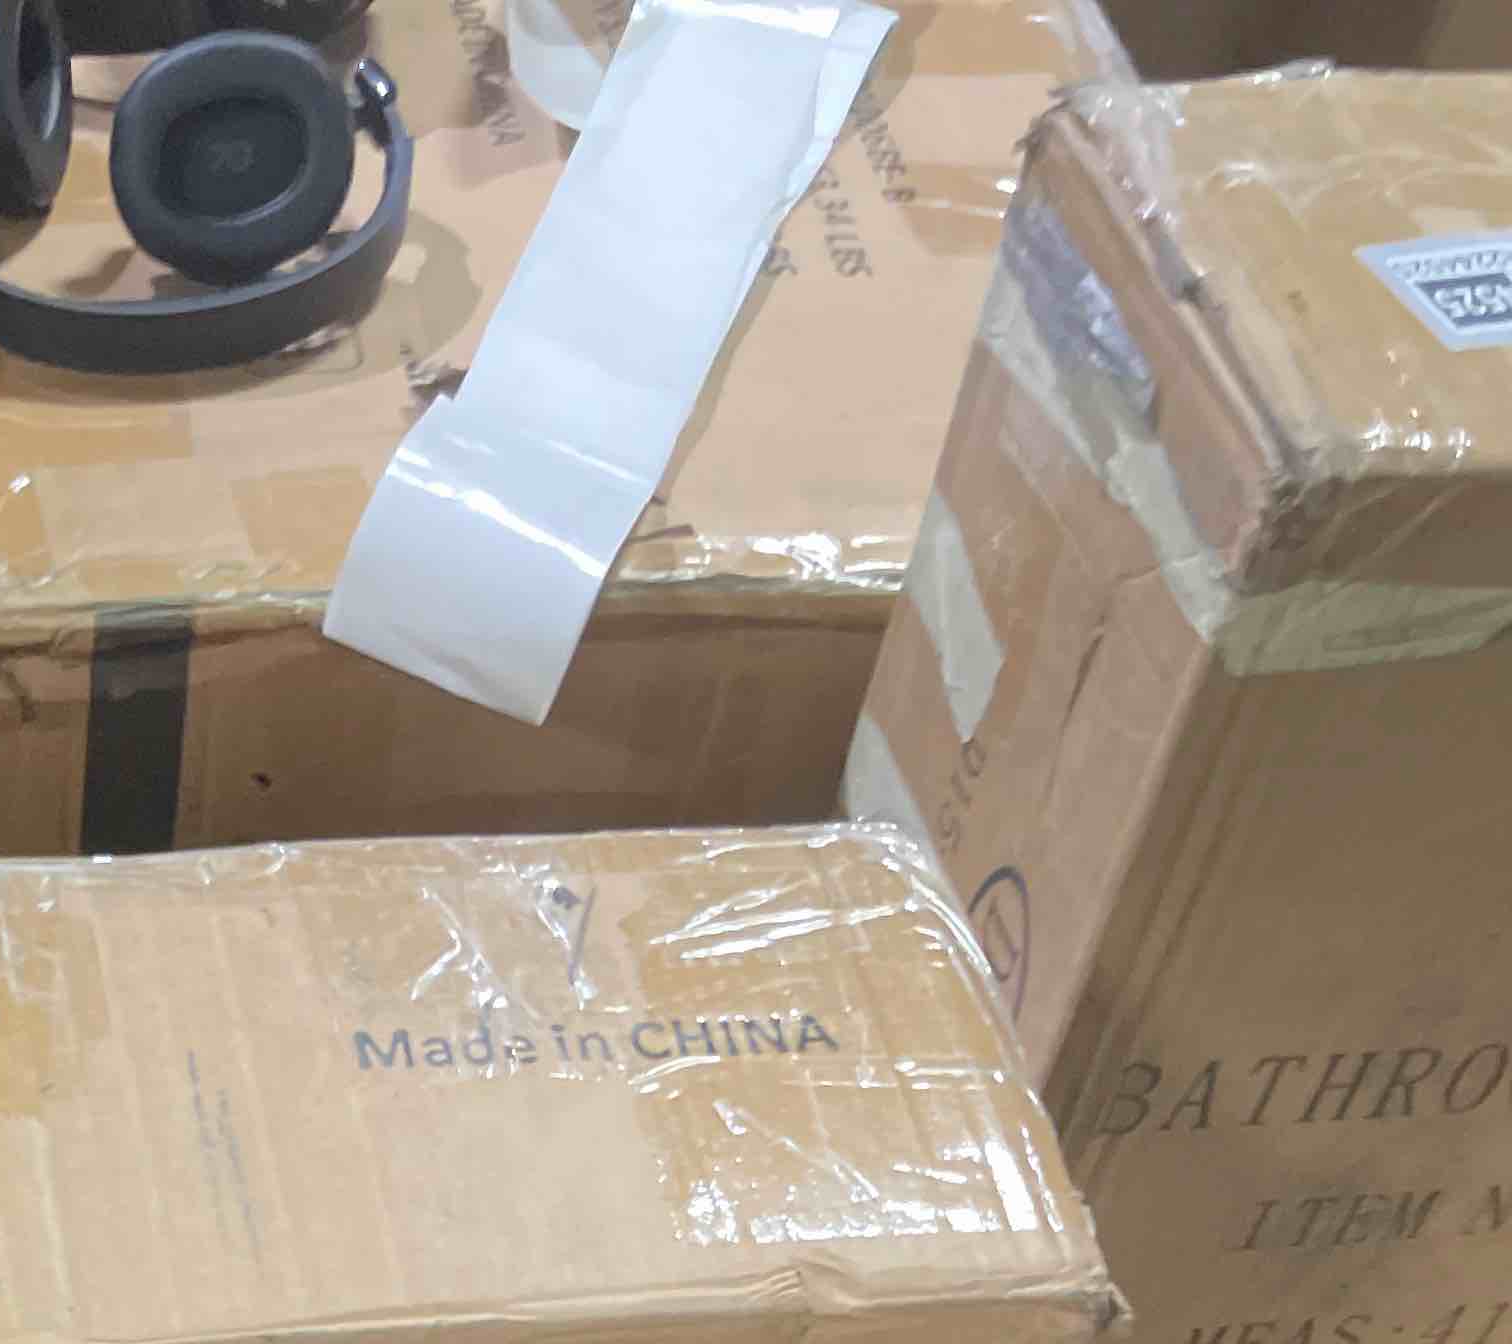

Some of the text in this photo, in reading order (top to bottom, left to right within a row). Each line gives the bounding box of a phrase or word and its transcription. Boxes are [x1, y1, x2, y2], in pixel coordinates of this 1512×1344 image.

[354, 1014, 839, 1071] Made in CHINA
[1095, 1041, 1512, 1136] BATHRO
[1233, 1188, 1442, 1251] ITEM
